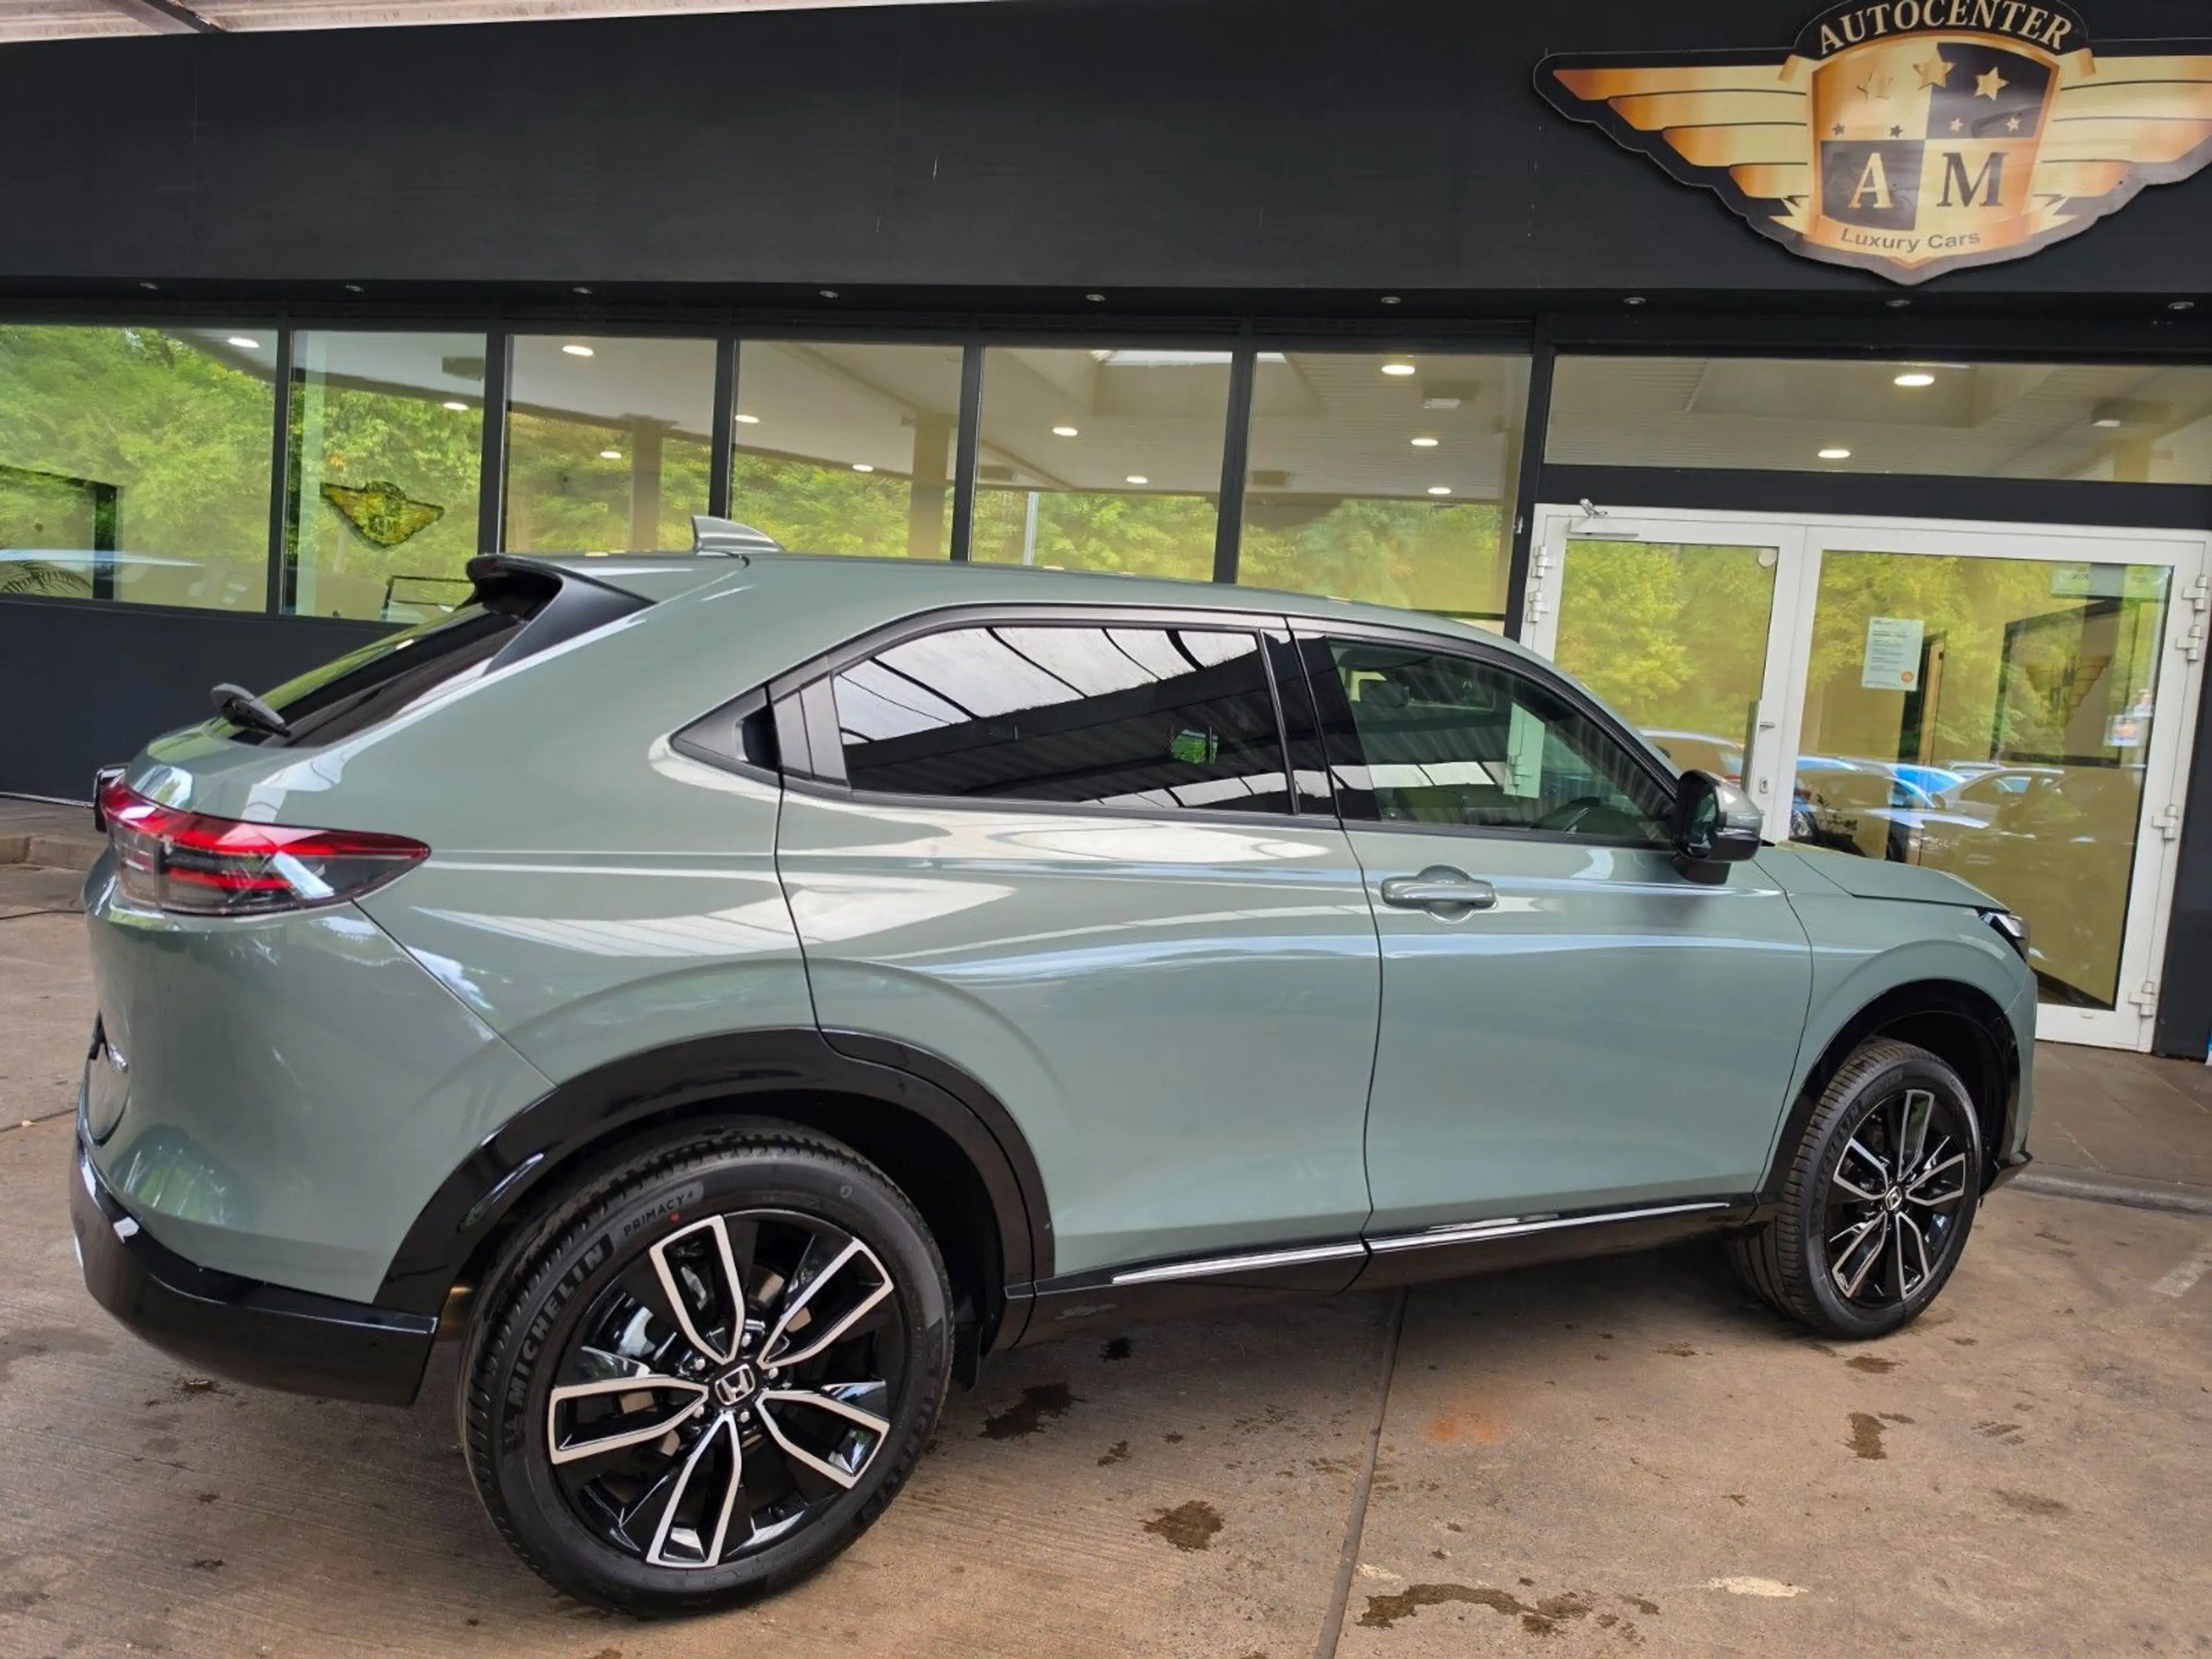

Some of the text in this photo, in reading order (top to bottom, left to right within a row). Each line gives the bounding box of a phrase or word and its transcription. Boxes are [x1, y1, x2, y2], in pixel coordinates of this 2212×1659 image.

[1820, 0, 2071, 55] AUTOCENTER
[1848, 152, 2010, 209] A M
[1841, 228, 1980, 252] Luxury Cars
[624, 1195, 684, 1236] PRIMACY
[507, 1243, 605, 1408] MICHELIN
